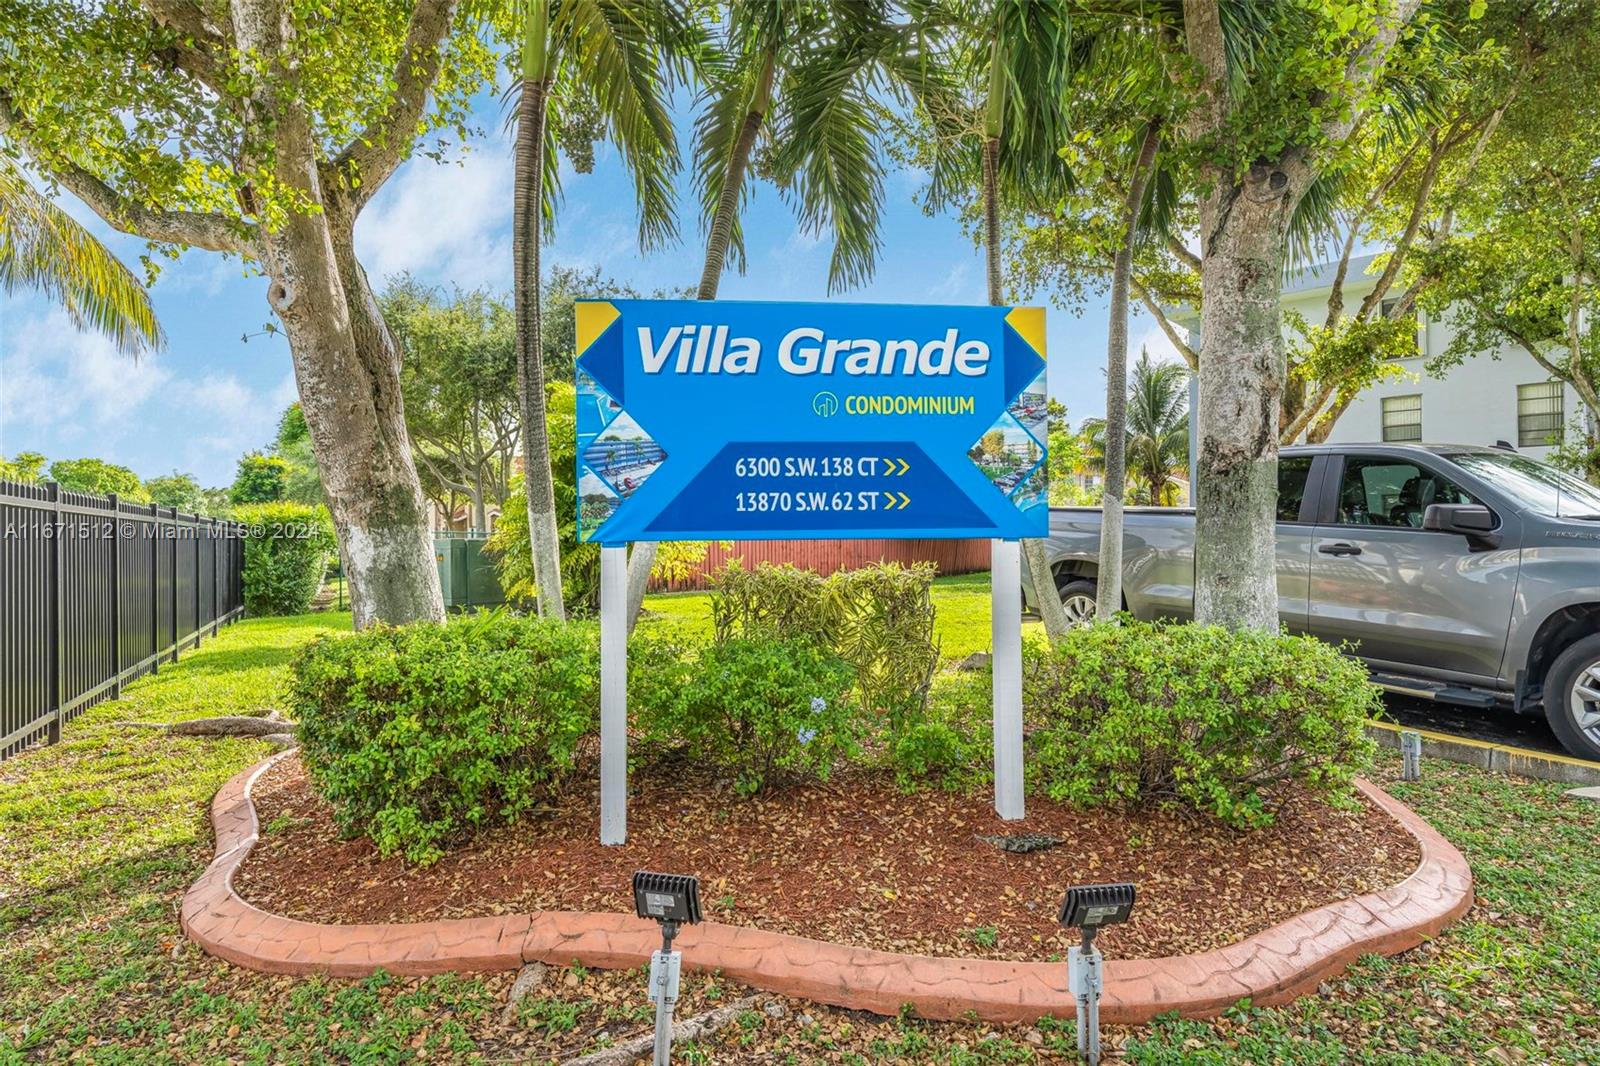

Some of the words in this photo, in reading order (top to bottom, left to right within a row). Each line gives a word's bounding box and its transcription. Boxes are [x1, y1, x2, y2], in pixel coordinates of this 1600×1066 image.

[637, 325, 762, 375] Villa
[777, 328, 991, 377] Grande
[845, 396, 974, 415] CONDOMINIUM
[735, 458, 781, 477] 6300
[784, 458, 819, 477] S.W.
[821, 458, 853, 476] 138
[857, 457, 879, 476] CT
[736, 492, 791, 511] 13870
[795, 492, 829, 511] S.W.
[831, 492, 852, 510] 62
[858, 492, 879, 510] ST
